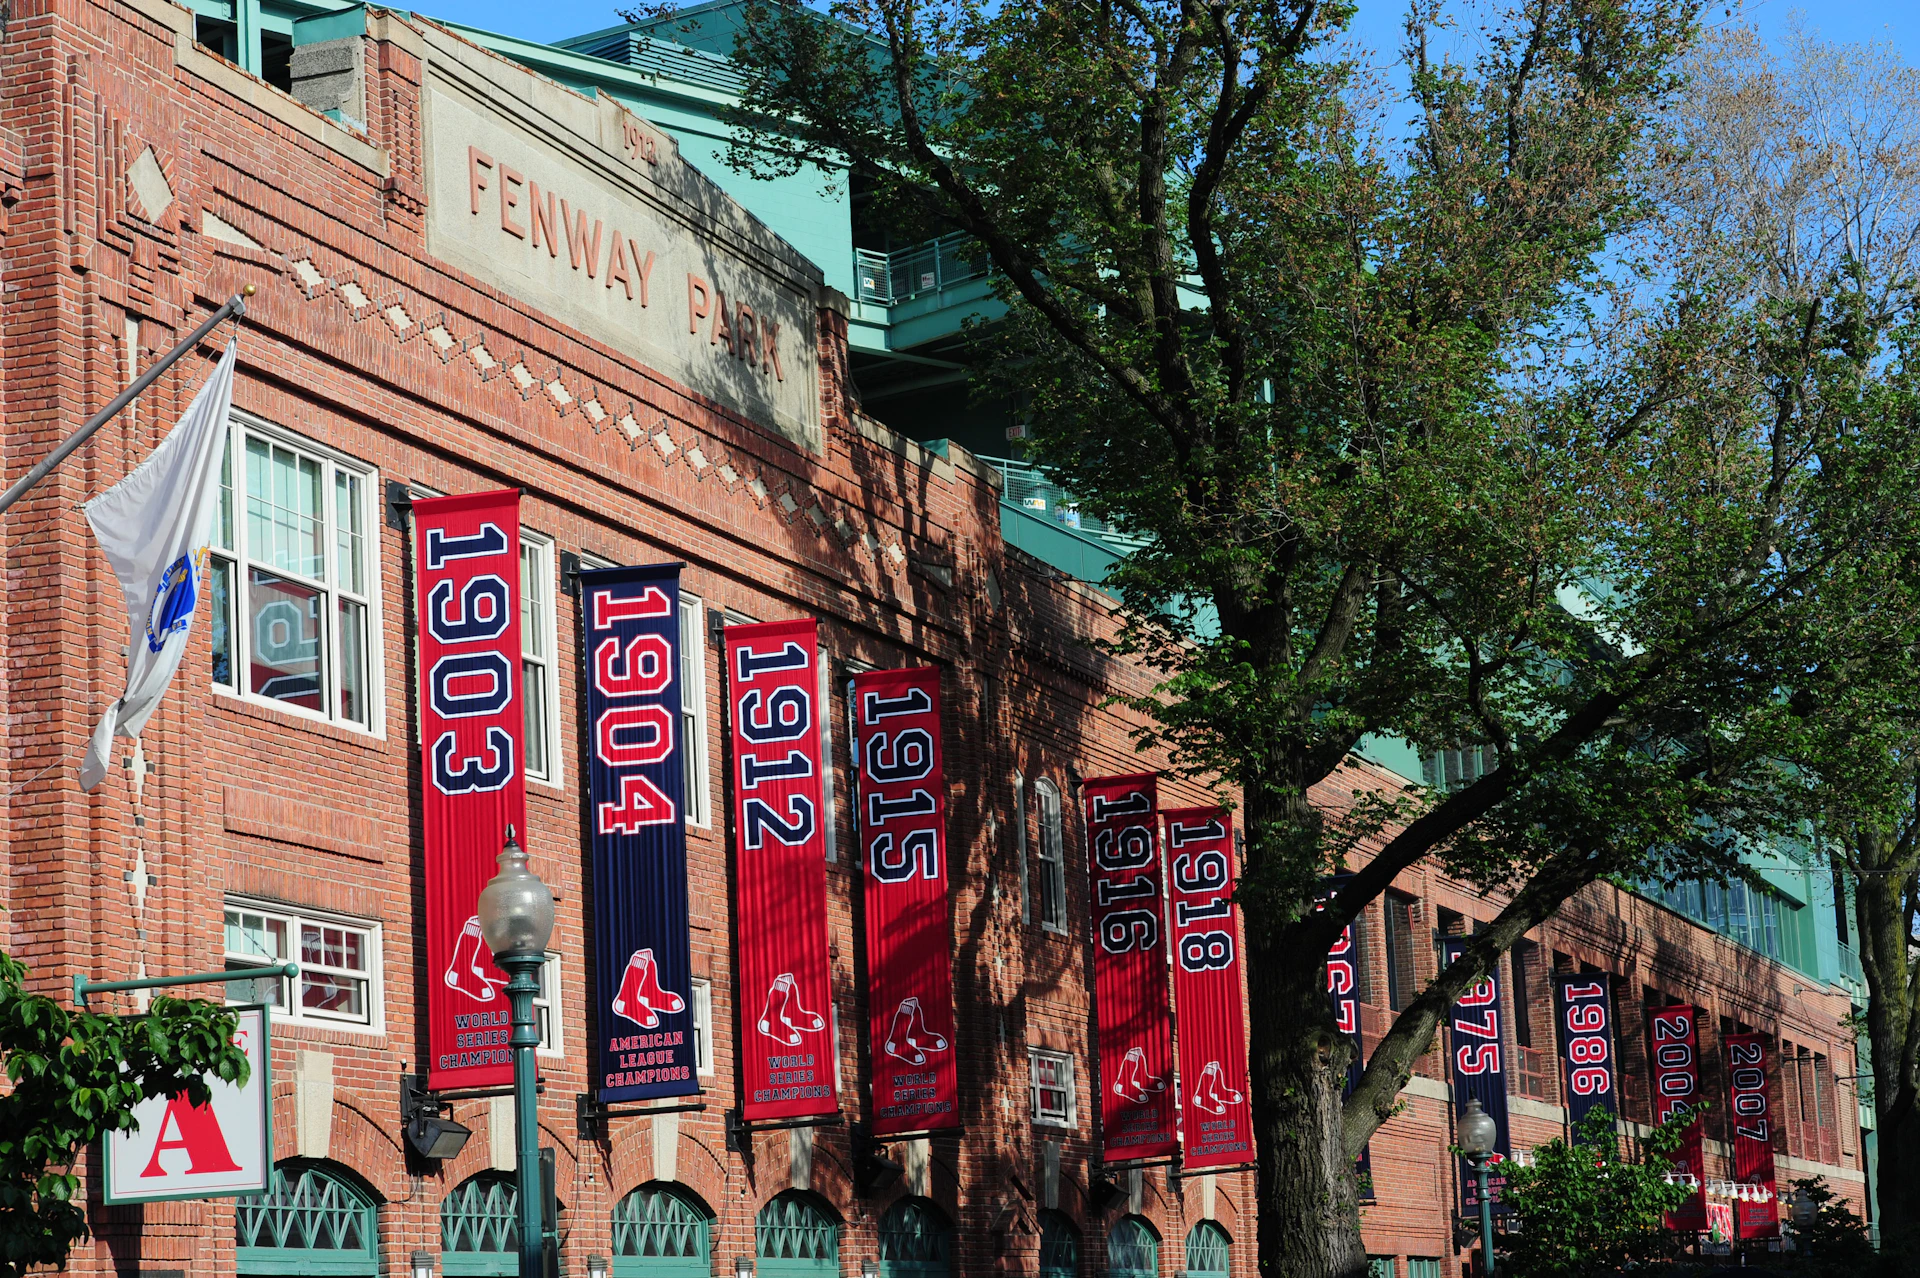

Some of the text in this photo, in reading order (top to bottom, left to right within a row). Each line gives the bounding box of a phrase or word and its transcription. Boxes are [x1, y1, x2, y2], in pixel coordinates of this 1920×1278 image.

[622, 120, 658, 166] 1912
[468, 144, 785, 382] FENWAY PARK
[426, 522, 514, 796] 1903
[593, 585, 677, 836] 1904
[736, 641, 816, 850] 1912
[863, 687, 939, 884] 1915
[1092, 792, 1159, 954] 1916
[1170, 819, 1235, 973] 1918
[454, 1011, 508, 1029] WORLD
[1451, 952, 1500, 1076] 975
[456, 1030, 508, 1048] SERIES
[609, 1031, 684, 1052] AMERICAN
[1564, 982, 1611, 1096] 1986
[439, 1049, 514, 1069] CHAMPION
[619, 1050, 674, 1068] LEAGUE
[767, 1054, 815, 1069] WORLD
[605, 1066, 690, 1088] CHAMPIONS
[769, 1070, 815, 1085] SERIES
[892, 1072, 937, 1087] WORLD
[754, 1085, 831, 1102] CHAMPIONS
[894, 1087, 936, 1101] SERIES
[1730, 1042, 1769, 1142] 2007
[880, 1101, 952, 1118] CHAMPIONS
[1120, 1109, 1159, 1121] WORLD
[140, 1088, 243, 1178] A
[1121, 1121, 1158, 1133] SERIES
[1200, 1120, 1236, 1132] WORLD
[1110, 1132, 1171, 1147] CHAMPIONS
[1201, 1131, 1235, 1143] SERIES
[1190, 1142, 1248, 1156] CHAMPIONS
